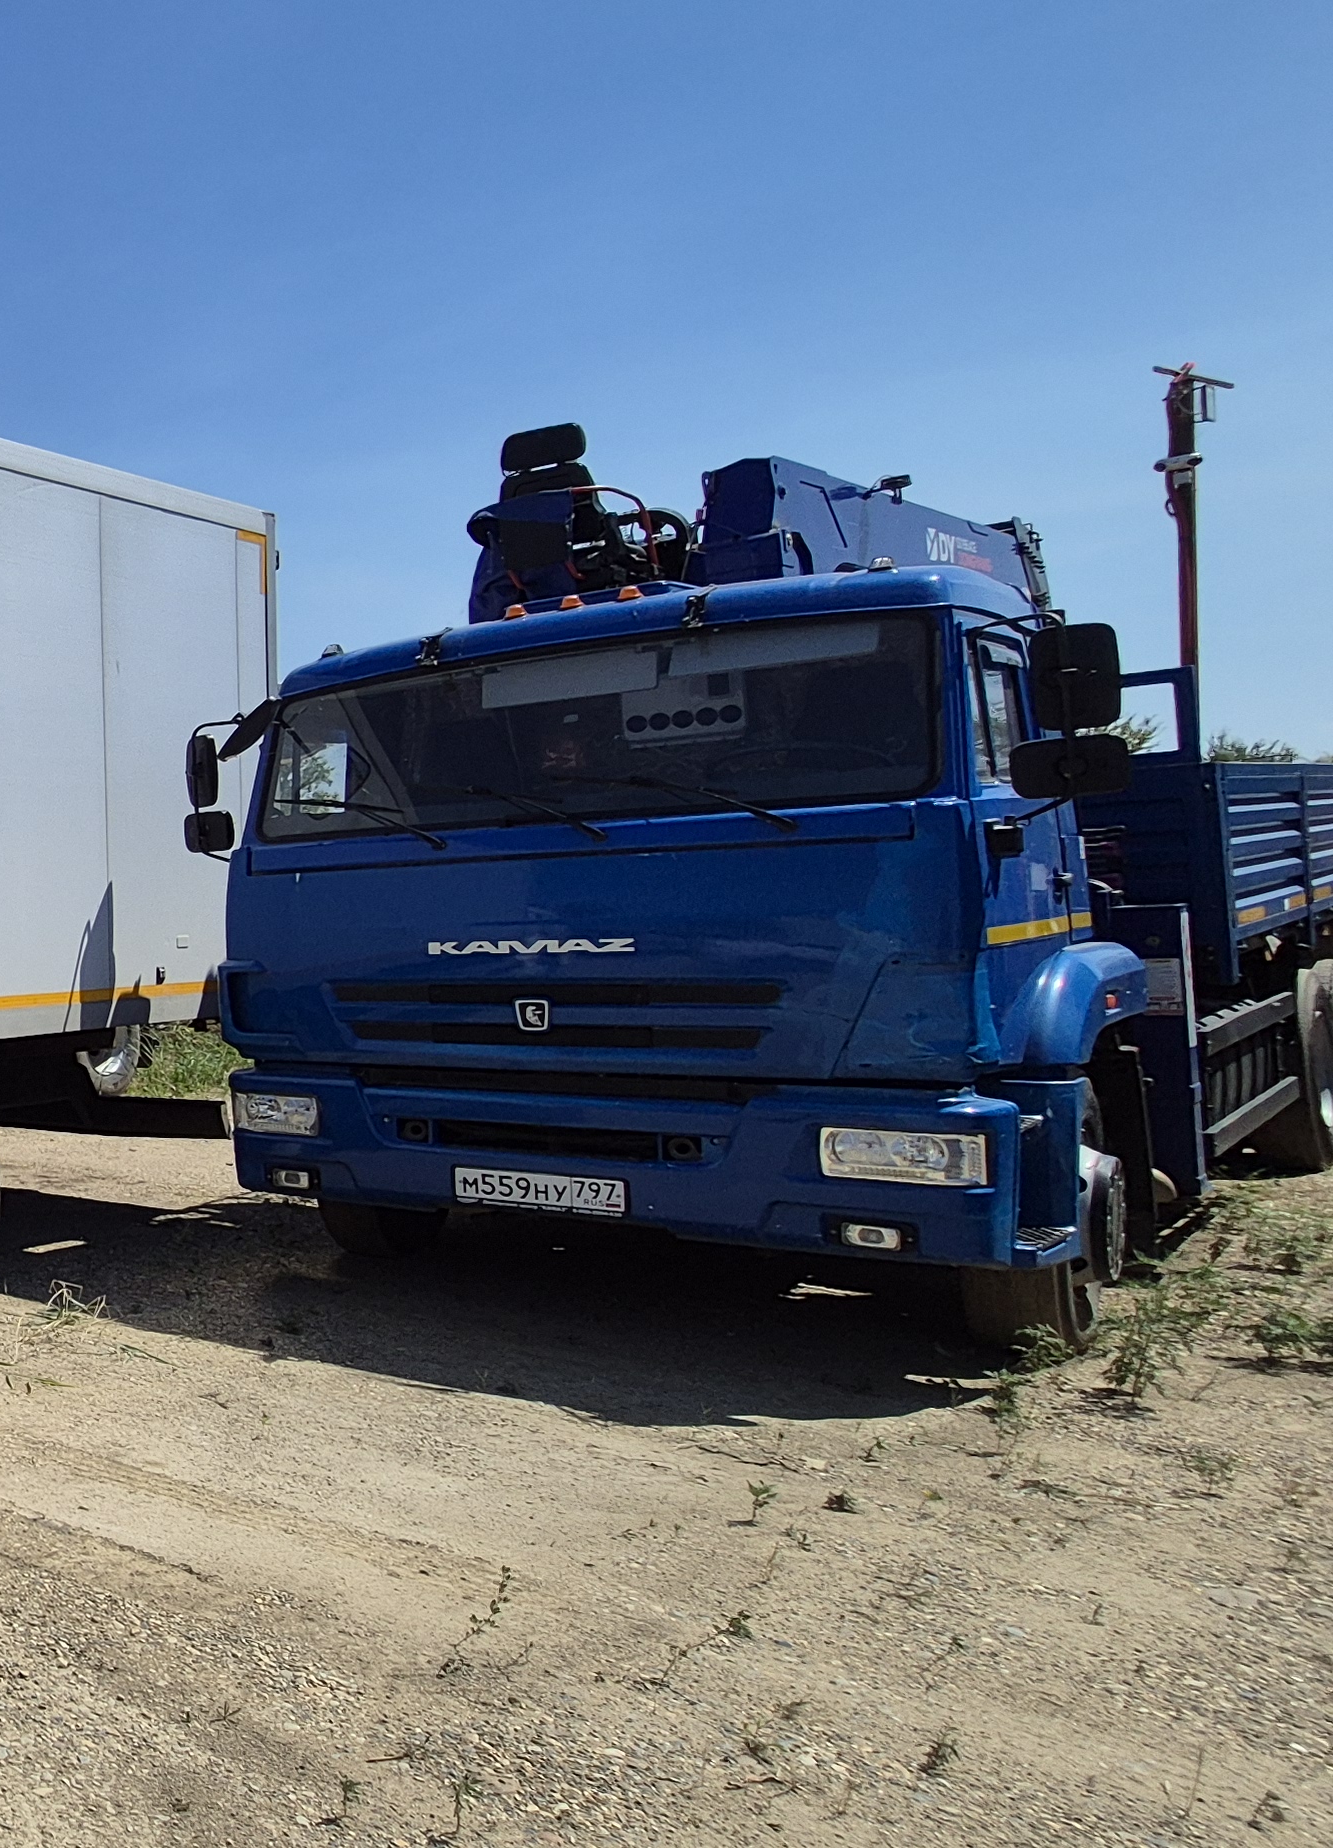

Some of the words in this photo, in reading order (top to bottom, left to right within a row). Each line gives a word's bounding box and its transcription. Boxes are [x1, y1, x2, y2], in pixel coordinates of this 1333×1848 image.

[428, 938, 636, 955] KAMAZ
[573, 1180, 617, 1202] 797
[583, 1198, 605, 1208] RUS
